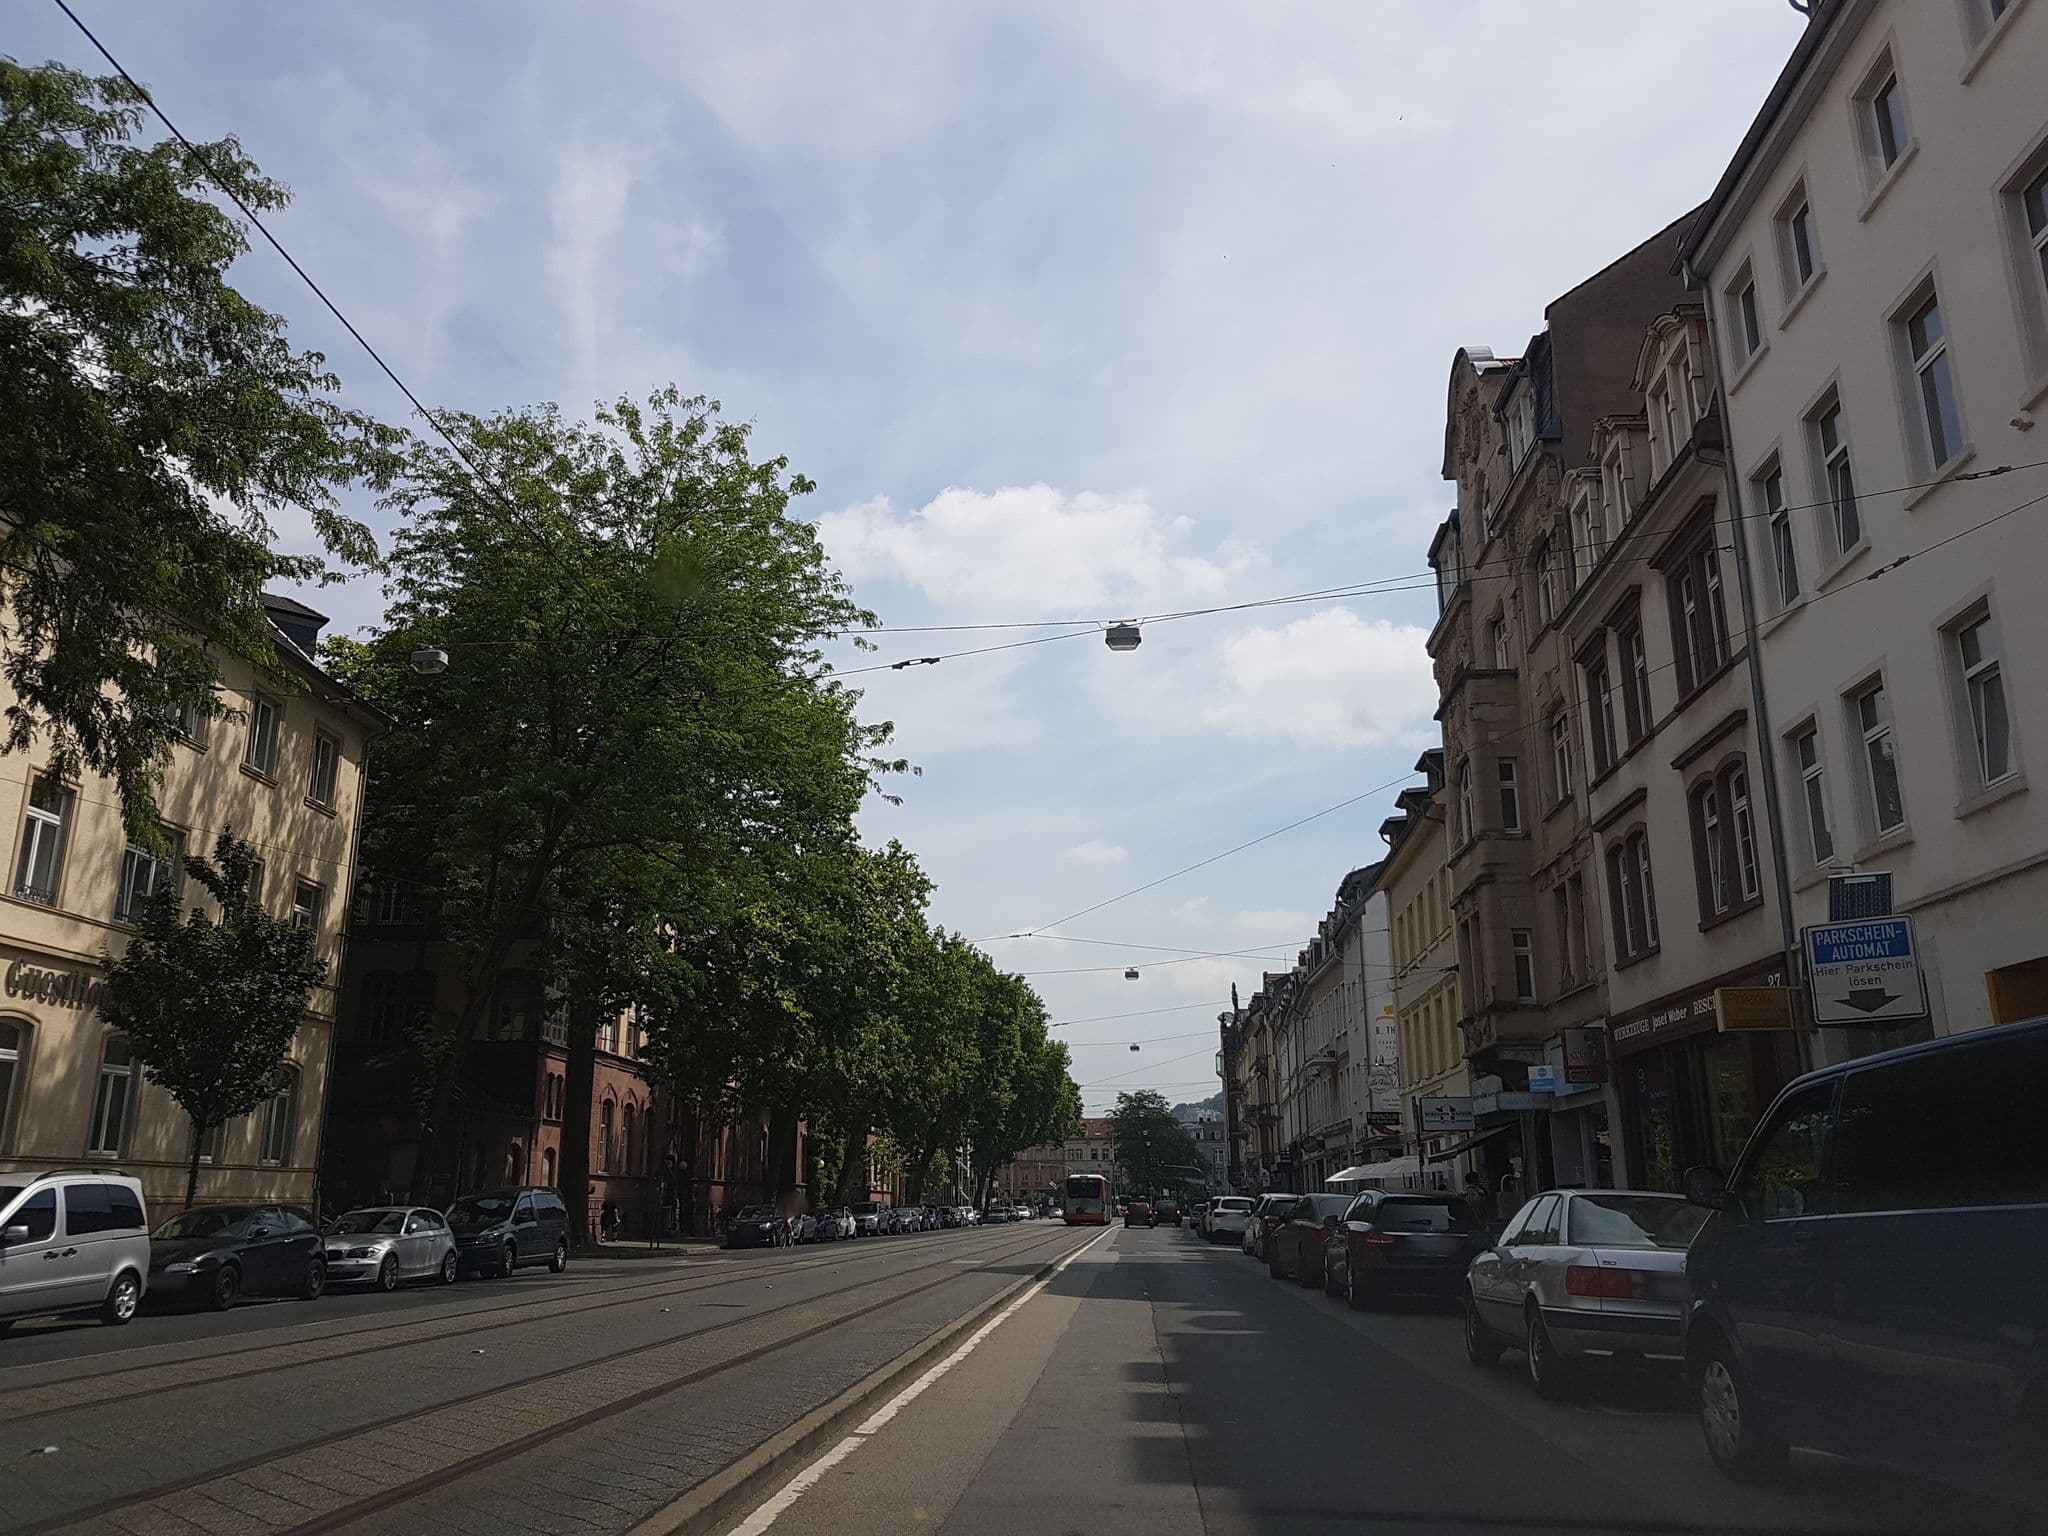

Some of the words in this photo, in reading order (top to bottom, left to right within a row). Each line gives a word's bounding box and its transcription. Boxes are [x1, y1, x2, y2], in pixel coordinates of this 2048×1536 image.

[1815, 923, 1903, 946] PARKSCHEIN-
[1832, 941, 1891, 961] AUTOMAT
[1815, 966, 1840, 977] Hier
[1845, 959, 1914, 974] Parkschein
[1767, 973, 1781, 988] 27
[1849, 976, 1882, 987] lösen
[1613, 1018, 1650, 1042] WERKZEUGE
[1667, 1007, 1688, 1024] Weber
